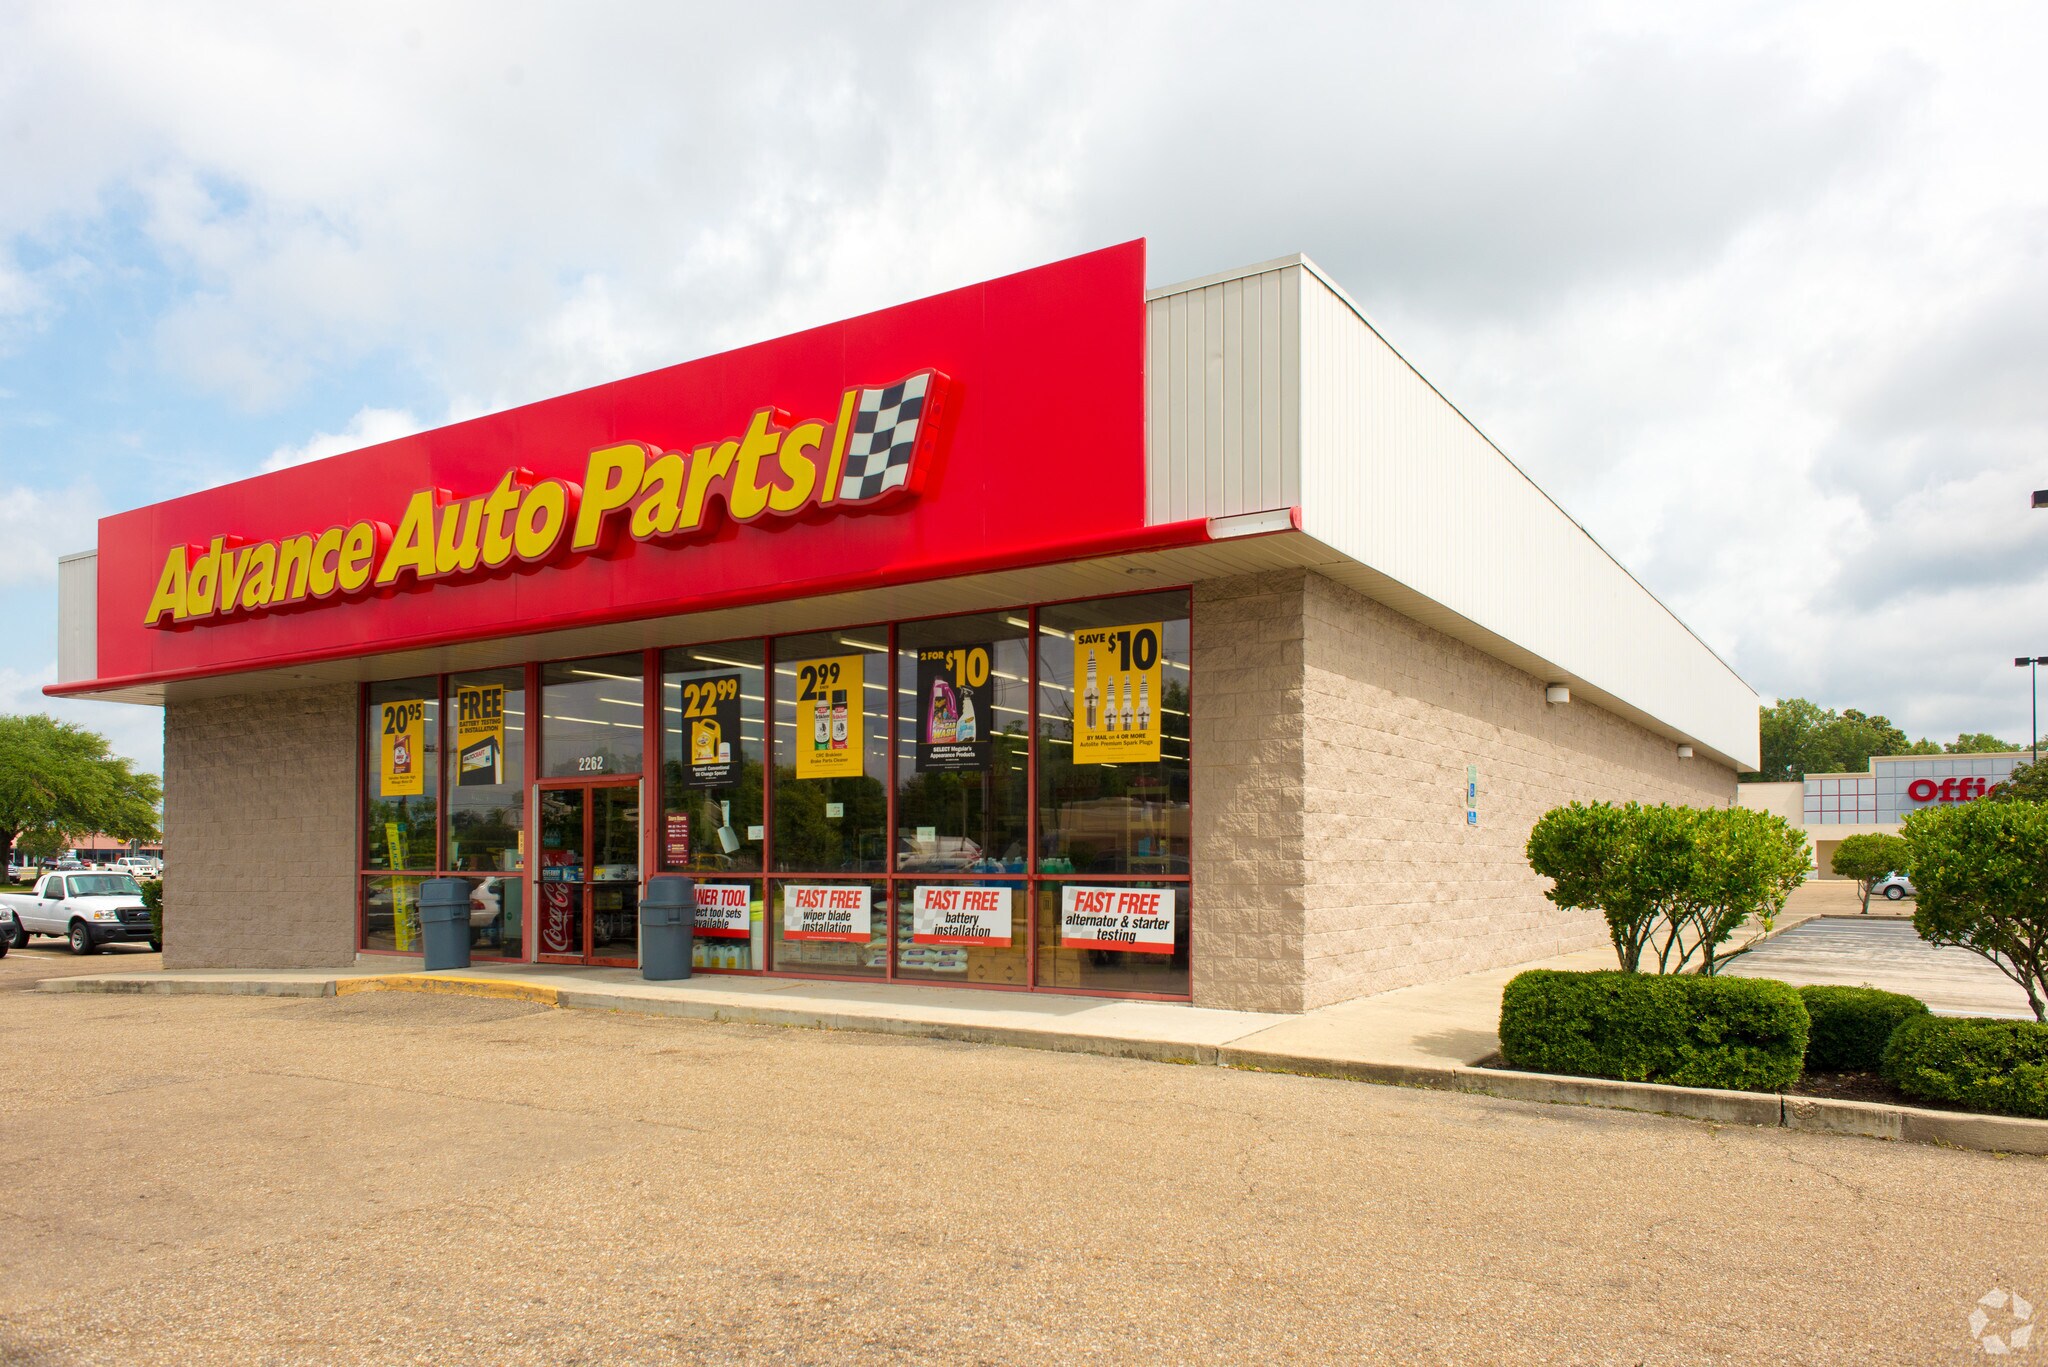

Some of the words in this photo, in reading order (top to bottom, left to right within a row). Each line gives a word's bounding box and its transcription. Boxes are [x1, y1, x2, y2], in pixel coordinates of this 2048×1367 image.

[144, 519, 374, 624] Advance
[375, 470, 567, 584] Auto
[573, 409, 823, 549] Parts
[1078, 633, 1105, 644] SAVE
[1108, 628, 1157, 671] $10
[921, 652, 927, 660] 2
[928, 651, 944, 660] FOR
[946, 647, 989, 688] $10
[459, 688, 502, 720] FREE
[465, 725, 498, 733] INSTALLATION
[578, 756, 604, 771] 2262
[721, 889, 747, 907] TOOL
[796, 889, 828, 908] FAST
[829, 890, 863, 909] FREE
[925, 890, 961, 910] FAST
[962, 891, 1000, 911] FREE
[1074, 891, 1116, 913] FAST
[1117, 893, 1161, 915] FREE
[709, 907, 725, 918] tool
[725, 909, 742, 919] sets
[803, 909, 827, 923] wiper
[828, 910, 852, 921] blade
[945, 912, 979, 928] battery
[694, 918, 730, 929] available
[802, 921, 852, 933] installation
[1065, 913, 1118, 927] alternator
[1120, 915, 1129, 928] &
[1132, 917, 1170, 930] starter
[934, 924, 991, 937] installation
[1096, 928, 1136, 944] testing
